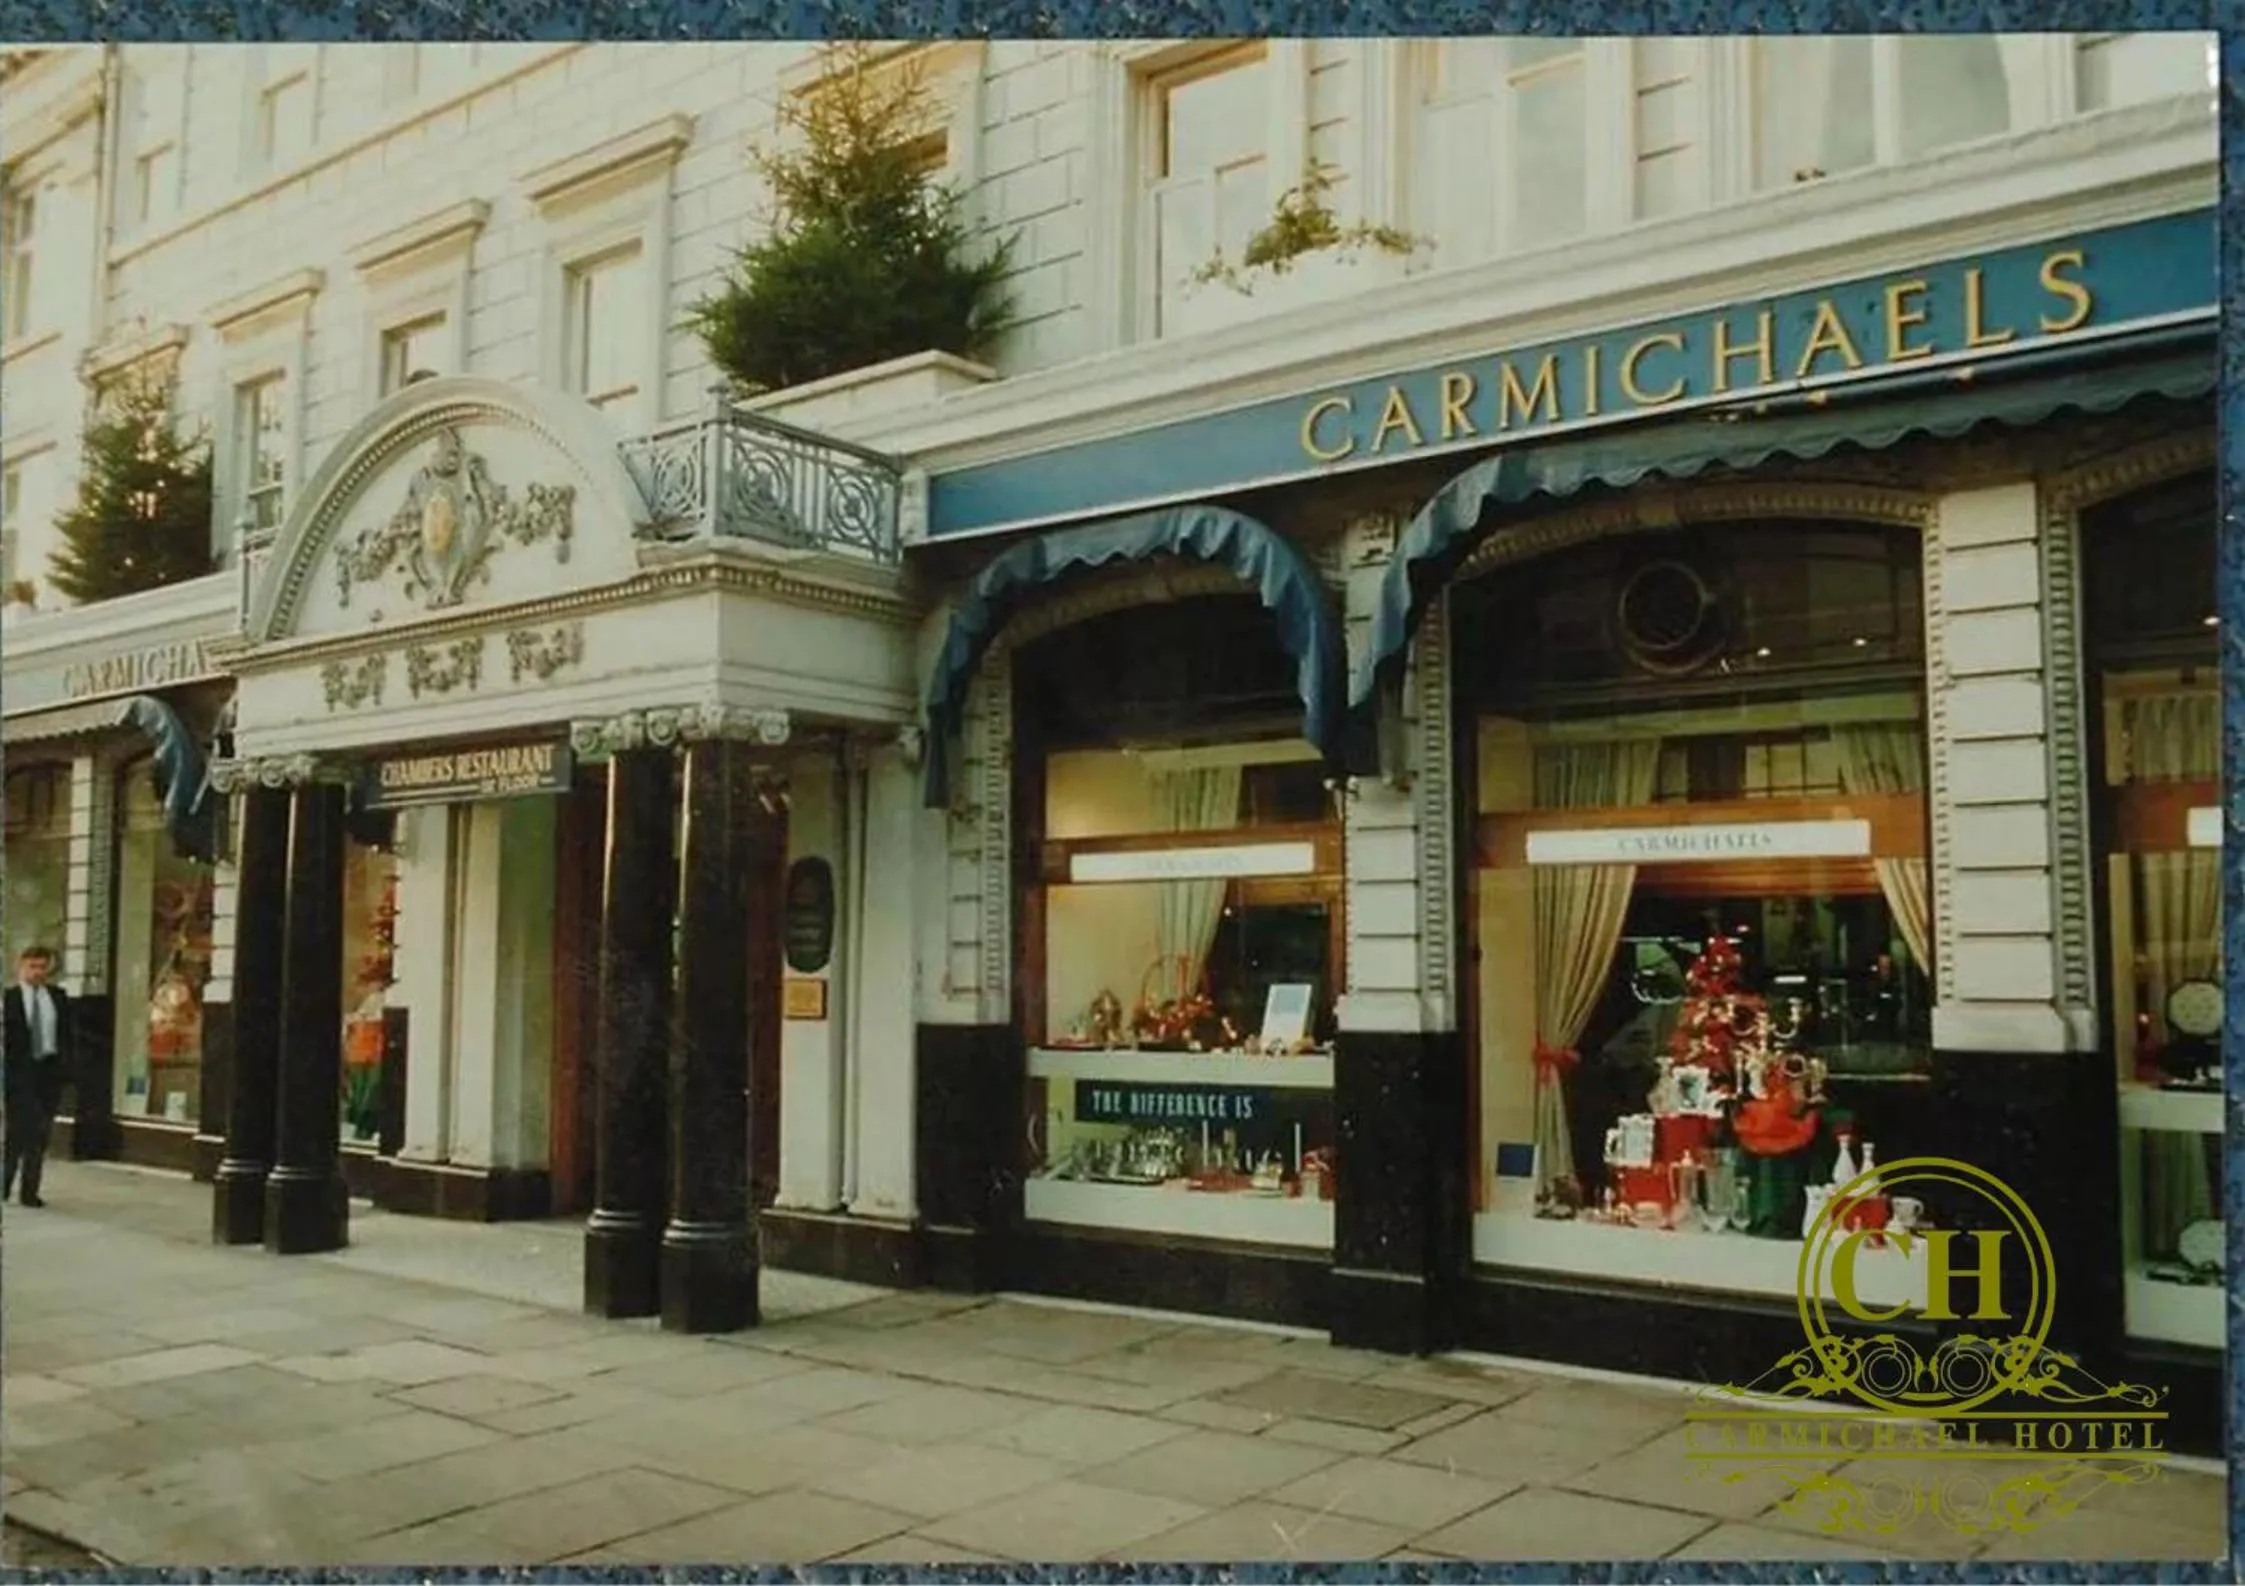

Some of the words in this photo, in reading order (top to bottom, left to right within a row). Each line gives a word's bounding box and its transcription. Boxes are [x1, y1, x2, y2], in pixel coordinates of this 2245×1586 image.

[1301, 251, 2093, 461] CARMICHAELS
[380, 757, 453, 788] CHAMBERS
[455, 744, 555, 781] RESTAURANT
[1093, 1090, 1121, 1114] THE
[1131, 1092, 1227, 1118] DIFFERENCE
[1235, 1095, 1254, 1120] IS
